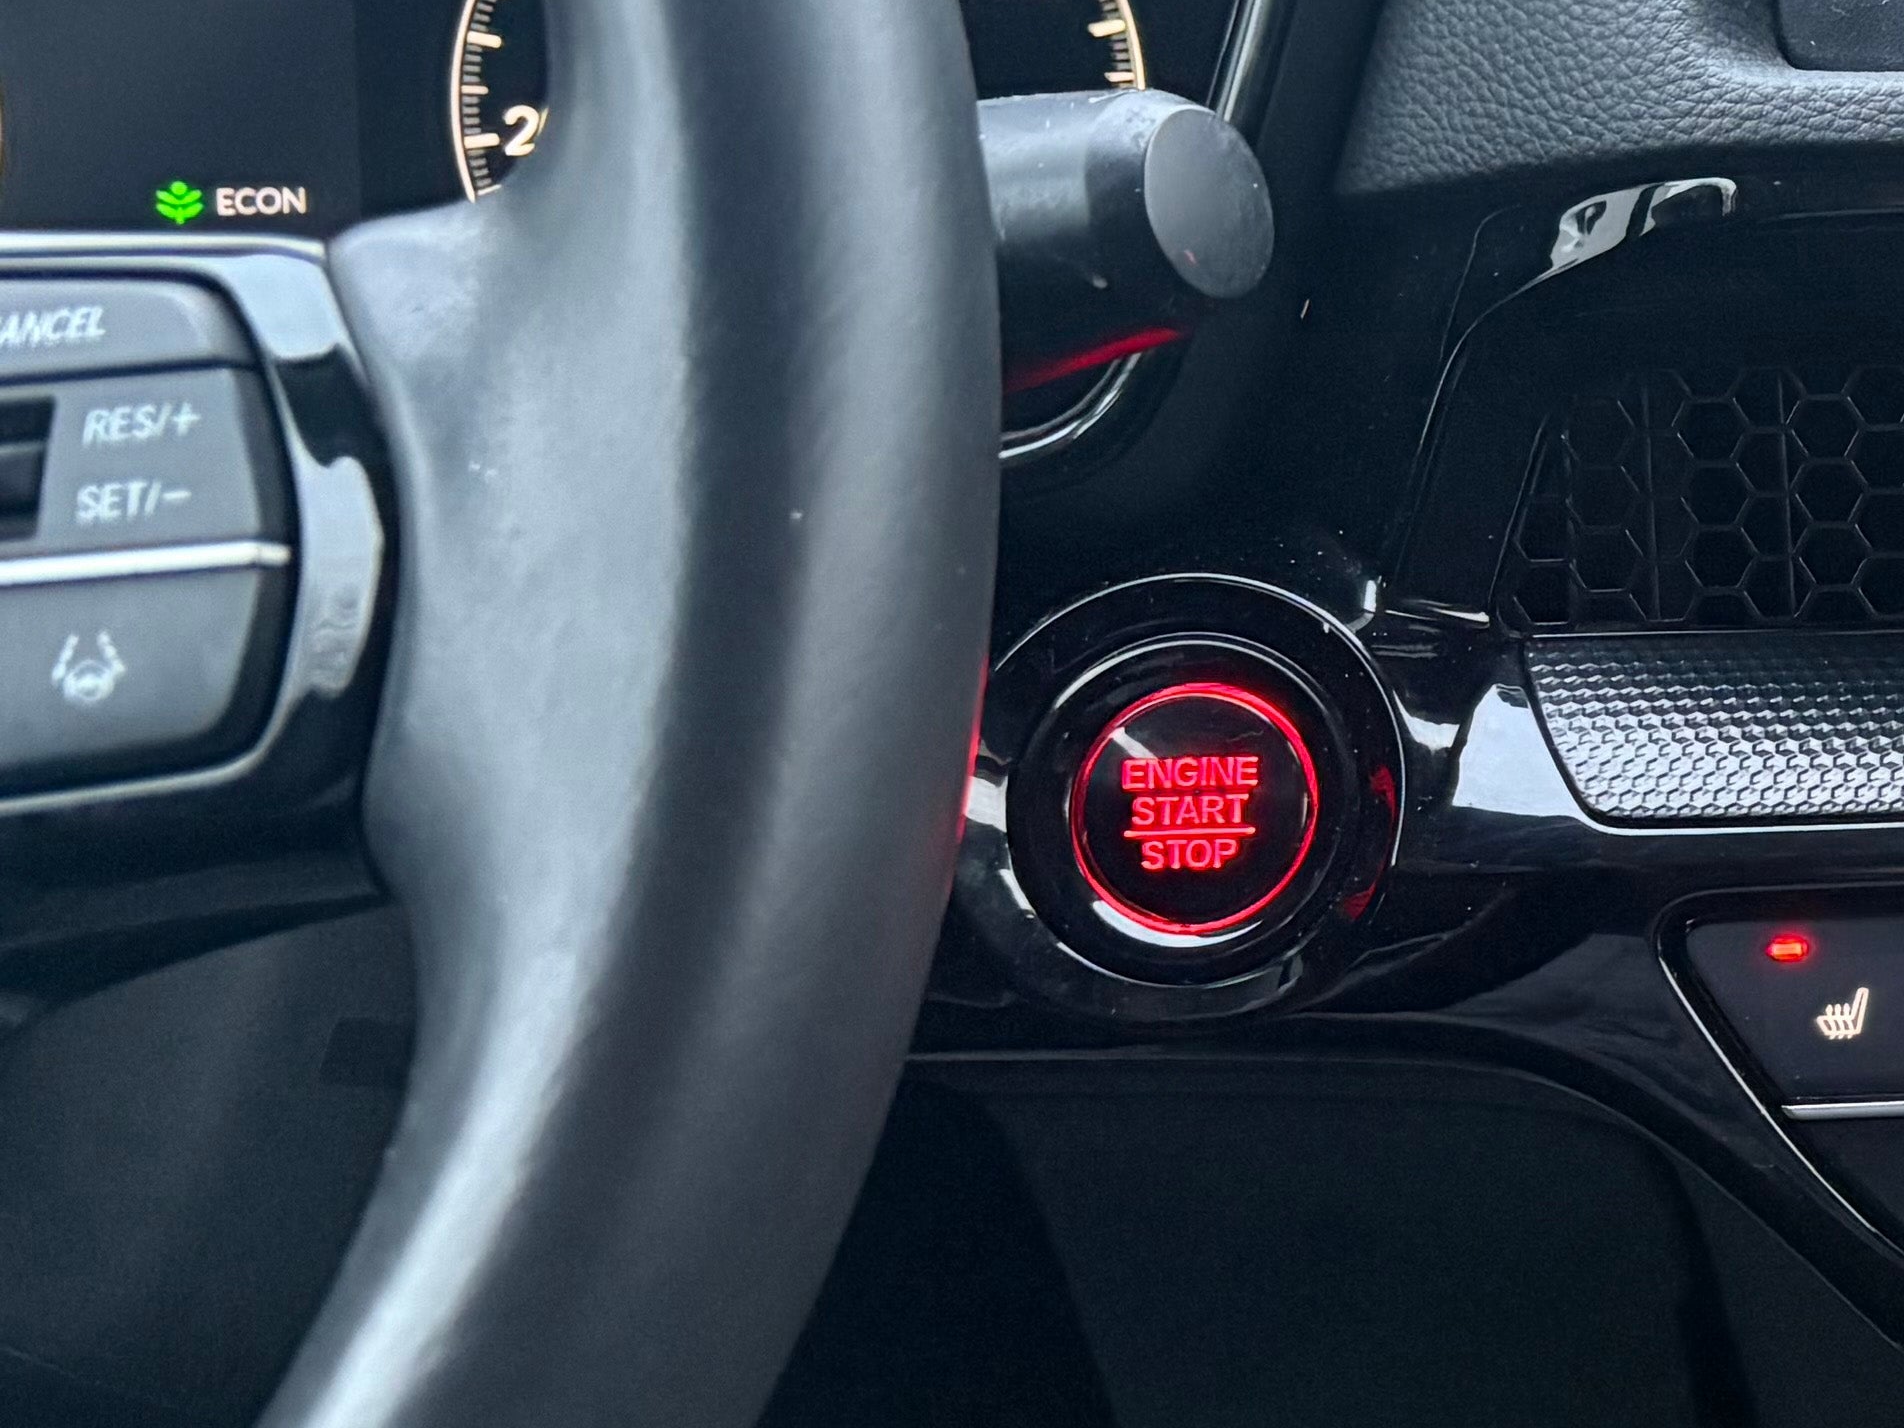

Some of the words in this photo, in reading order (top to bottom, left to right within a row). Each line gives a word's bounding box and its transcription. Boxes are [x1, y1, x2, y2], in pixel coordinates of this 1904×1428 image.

[215, 186, 307, 217] ECON
[0, 306, 107, 348] ANCEL
[1122, 755, 1259, 790] ENGINE
[1132, 794, 1250, 826] START
[1141, 838, 1239, 870] STOP
